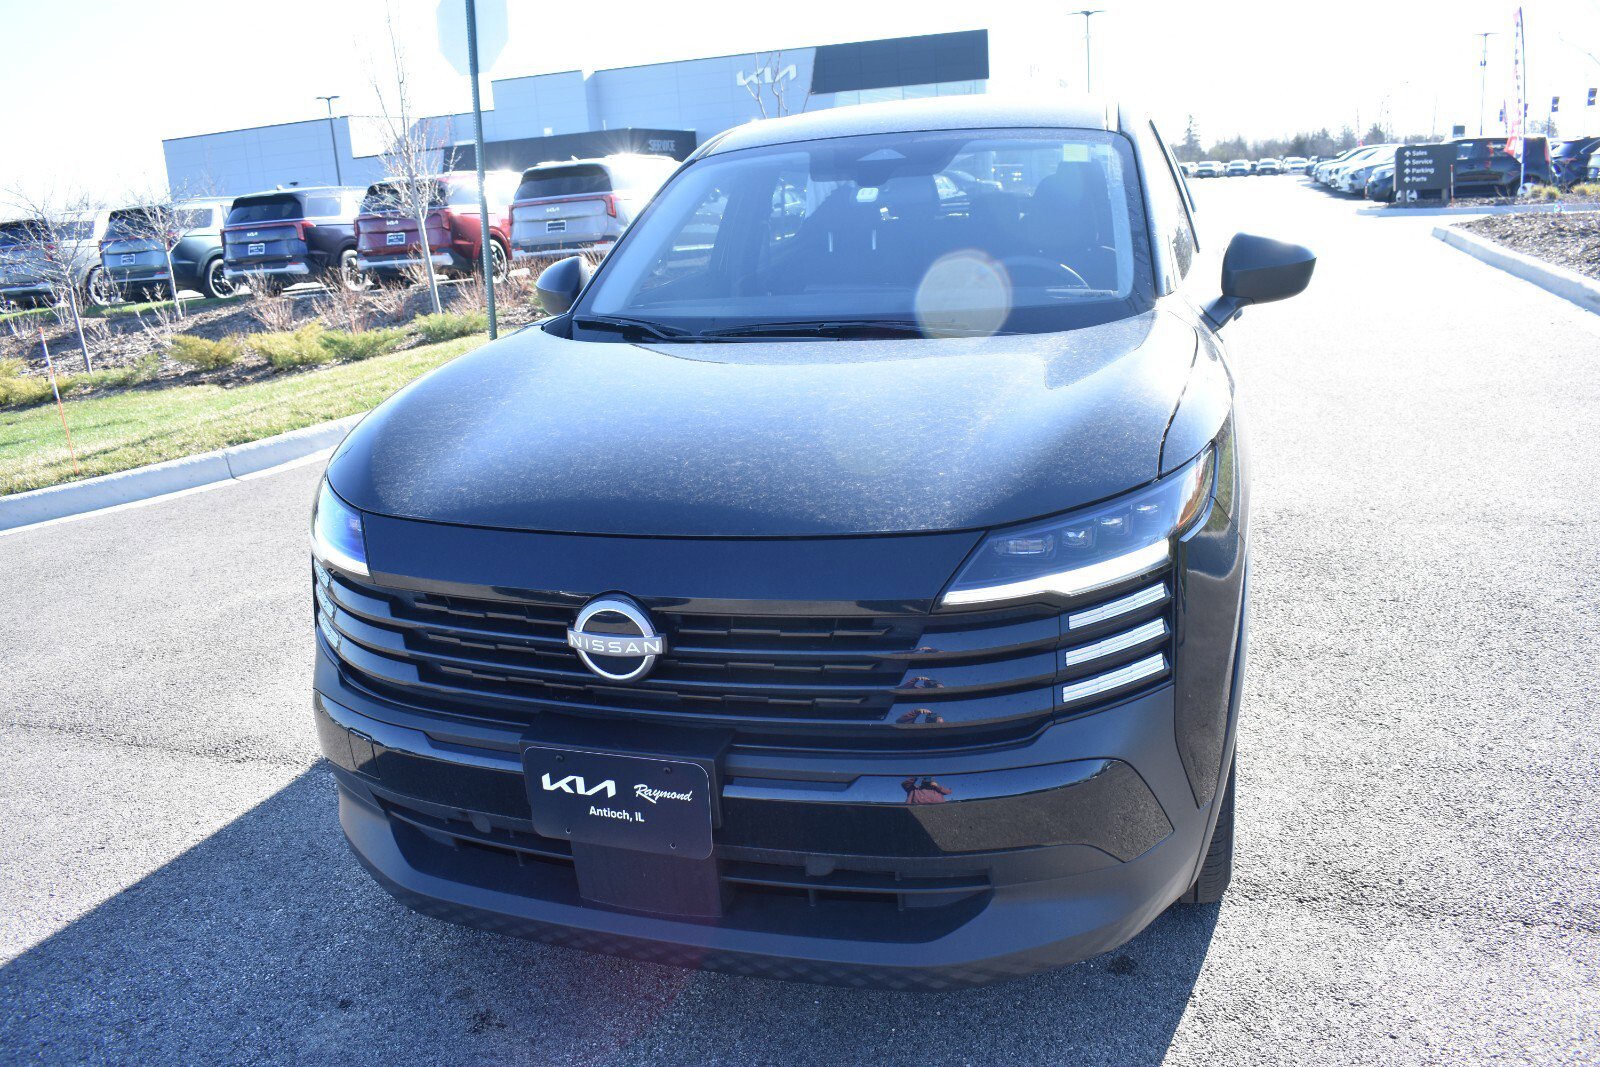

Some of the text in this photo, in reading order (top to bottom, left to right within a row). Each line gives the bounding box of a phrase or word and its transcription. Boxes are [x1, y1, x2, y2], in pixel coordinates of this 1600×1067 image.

[736, 64, 797, 86] KIA
[648, 139, 676, 152] SERVICE
[569, 633, 660, 654] NISSAN
[541, 772, 693, 804] KIA Raymond
[589, 805, 645, 823] Antioch, IL
